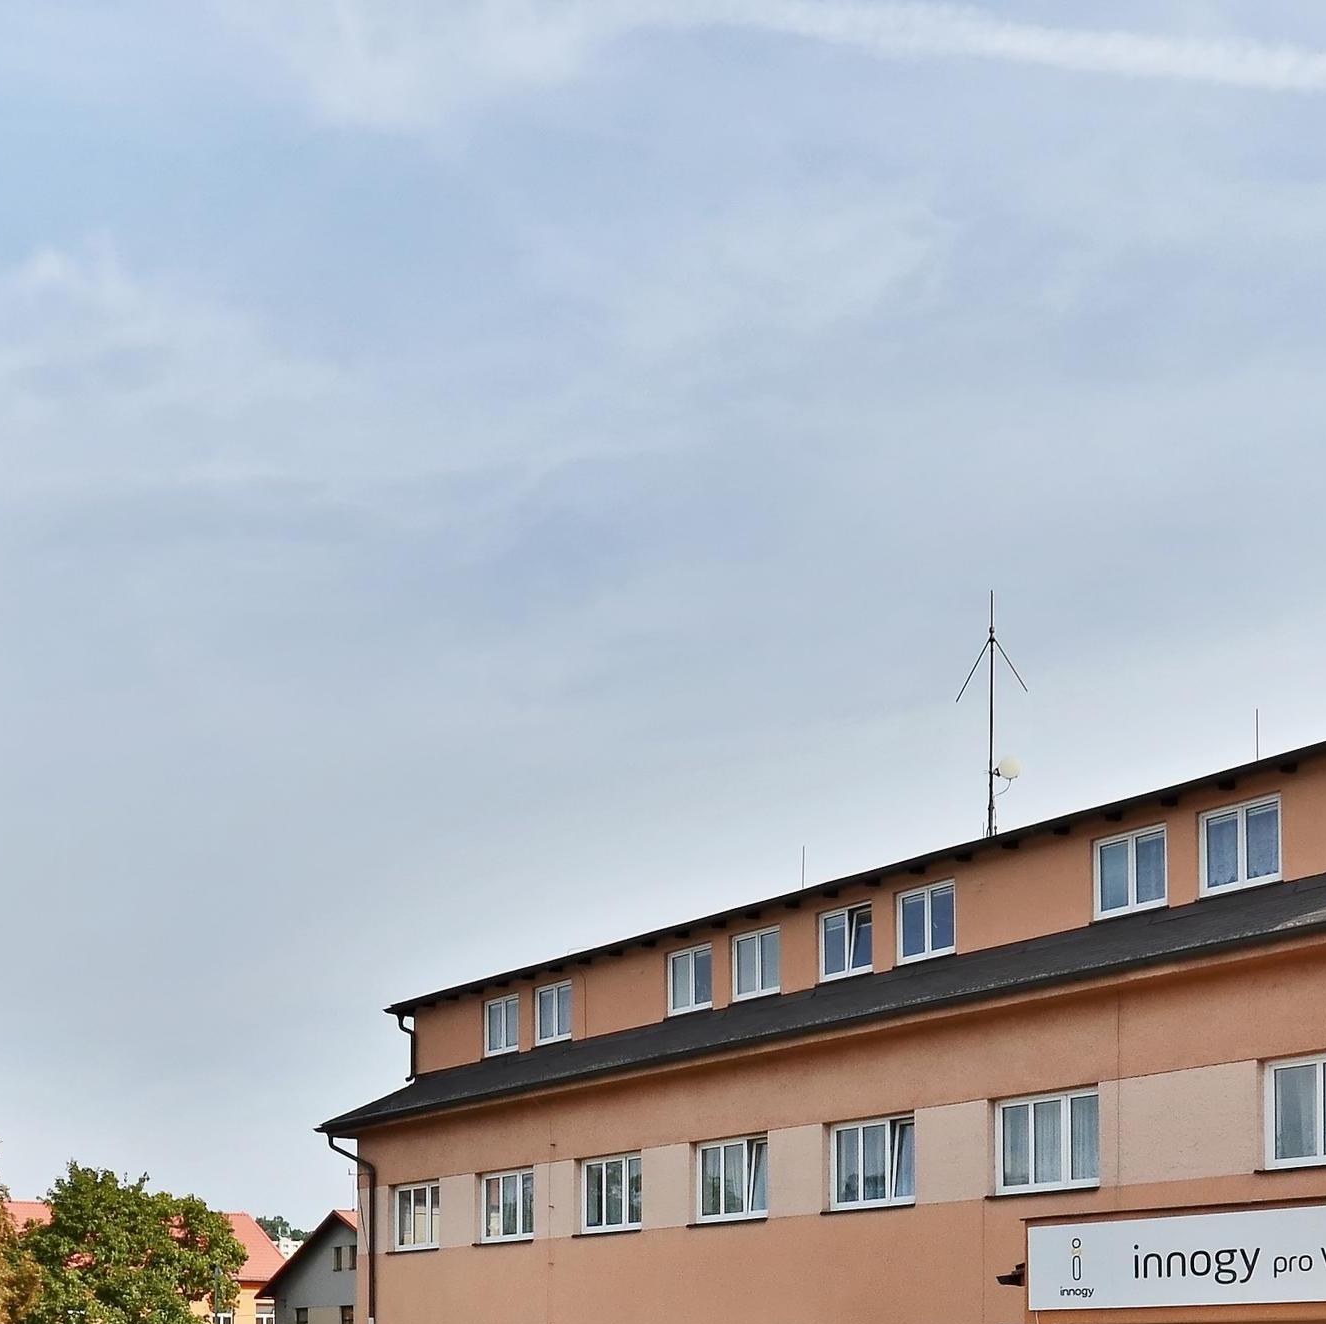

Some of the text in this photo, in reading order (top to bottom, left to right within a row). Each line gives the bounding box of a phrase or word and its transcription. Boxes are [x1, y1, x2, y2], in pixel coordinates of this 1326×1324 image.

[1133, 1245, 1261, 1284] innogy
[1272, 1254, 1313, 1279] pro
[1059, 1285, 1095, 1298] innogy
